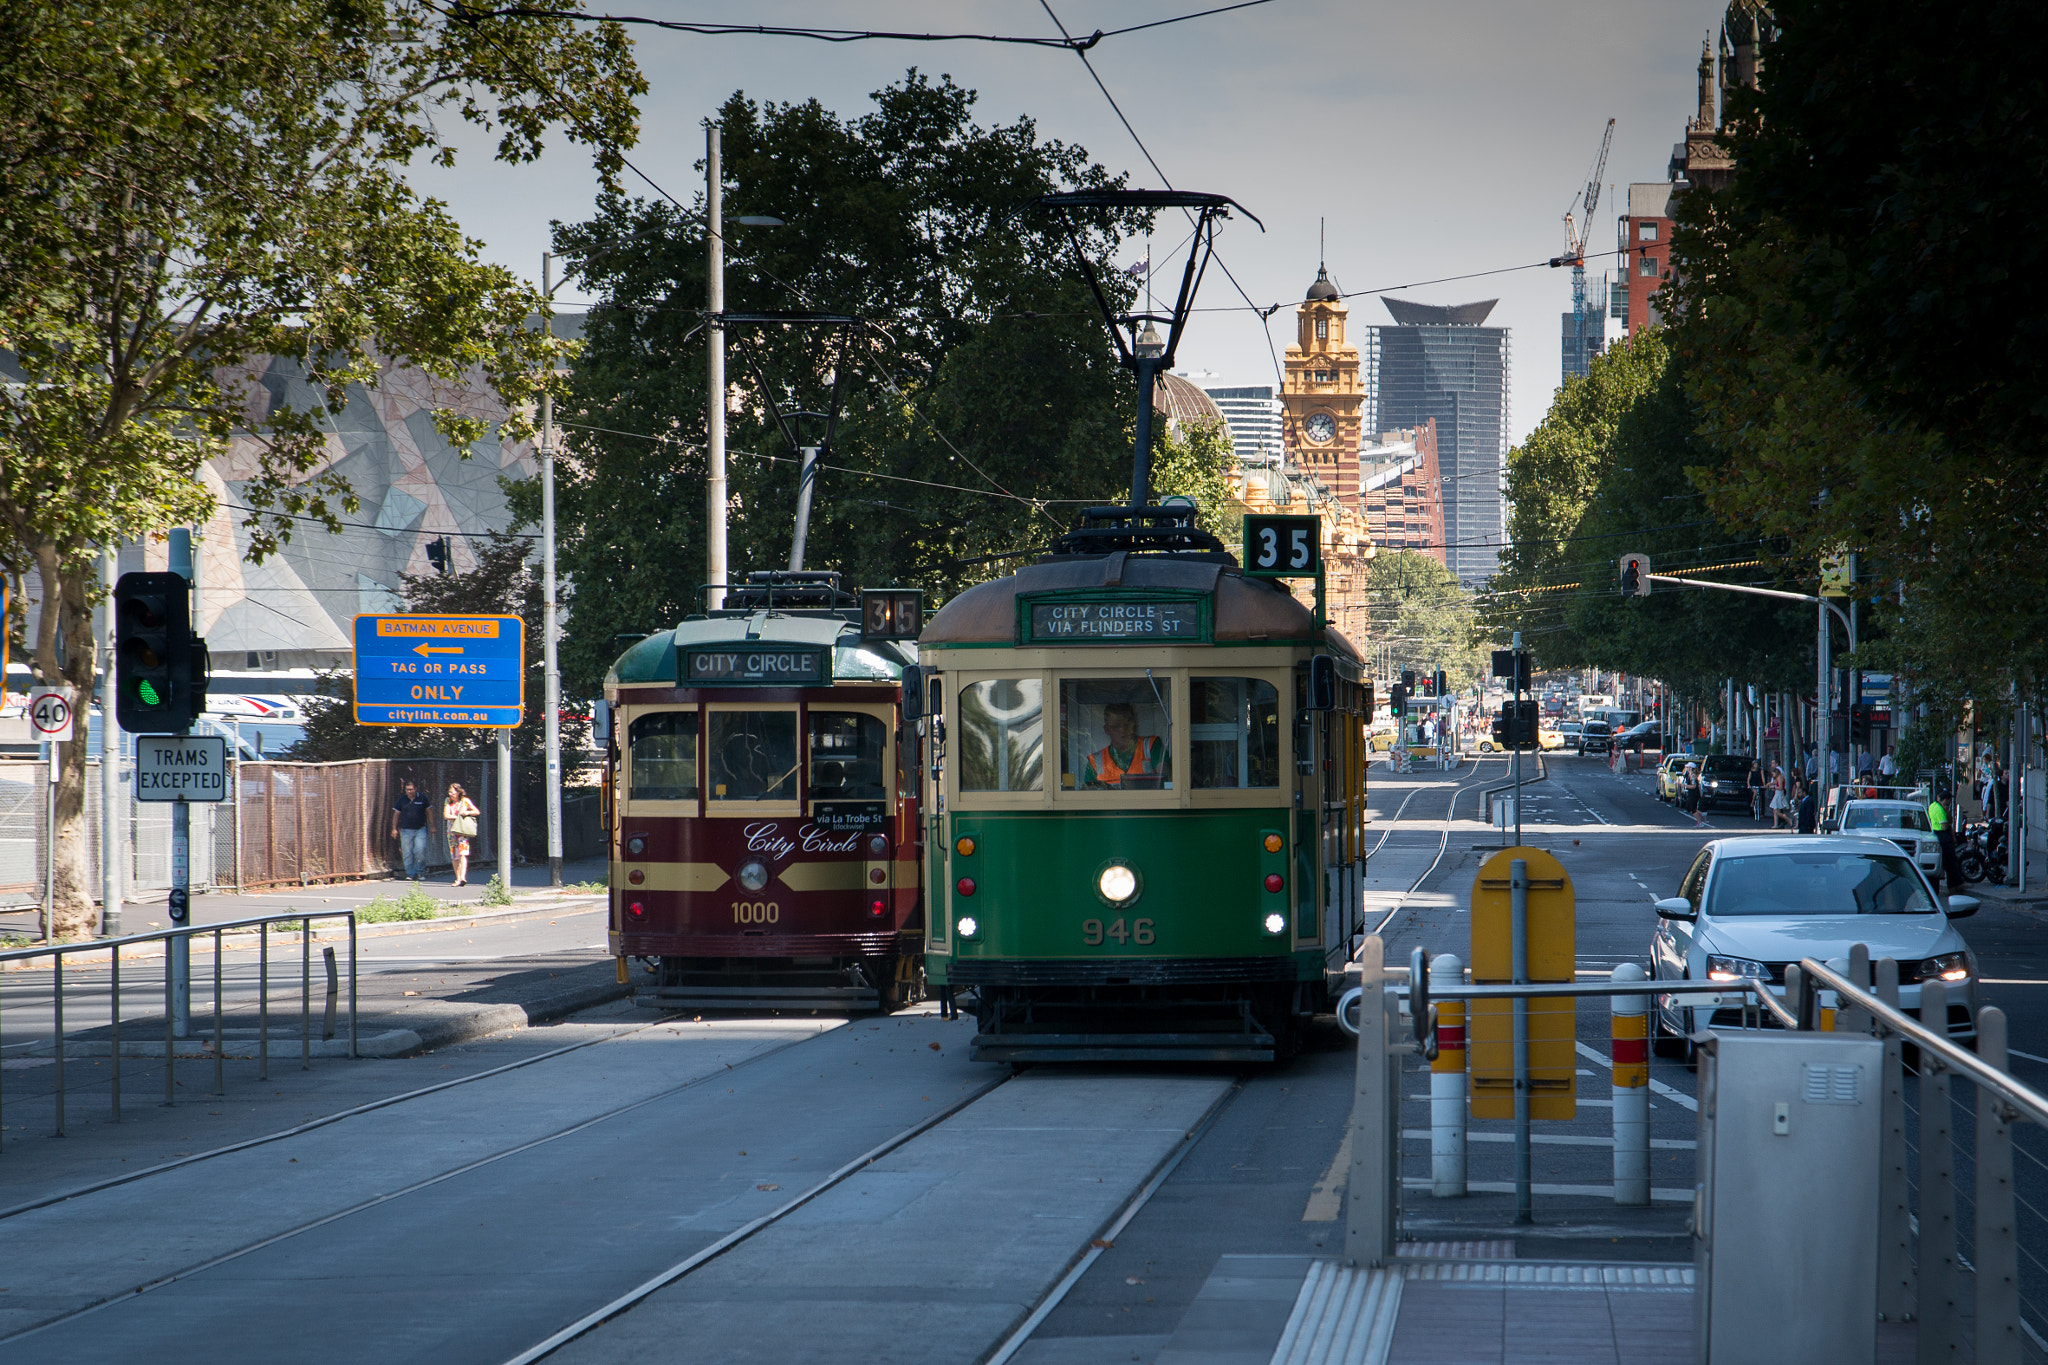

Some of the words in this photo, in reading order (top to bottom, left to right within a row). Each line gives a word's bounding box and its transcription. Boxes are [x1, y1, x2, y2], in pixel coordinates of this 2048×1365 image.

[1257, 527, 1309, 569] 35
[1052, 607, 1089, 619] CITY
[1099, 606, 1155, 618] CIRCLE
[385, 623, 436, 633] BATMAN
[442, 624, 491, 634] AVENUE
[1048, 621, 1072, 633] VIA
[1081, 620, 1153, 632] FLINDERS
[1162, 620, 1180, 632] ST
[391, 663, 417, 673] TAG
[424, 664, 442, 673] OR
[449, 664, 487, 674] PASS
[696, 654, 738, 672] CITY
[747, 654, 812, 672] CIRCLE
[411, 685, 463, 700] ONLY
[36, 704, 66, 723] 40
[388, 710, 488, 721] citylink.com.au
[154, 750, 208, 765] TRAMS
[141, 772, 221, 788] EXCEPTED
[817, 815, 830, 823] via
[833, 814, 843, 823] La
[846, 814, 870, 823] Trobe
[873, 814, 882, 823] St
[743, 822, 796, 860] City
[798, 823, 862, 852] Circle
[731, 902, 779, 923] 1000
[1082, 918, 1156, 946] 946
